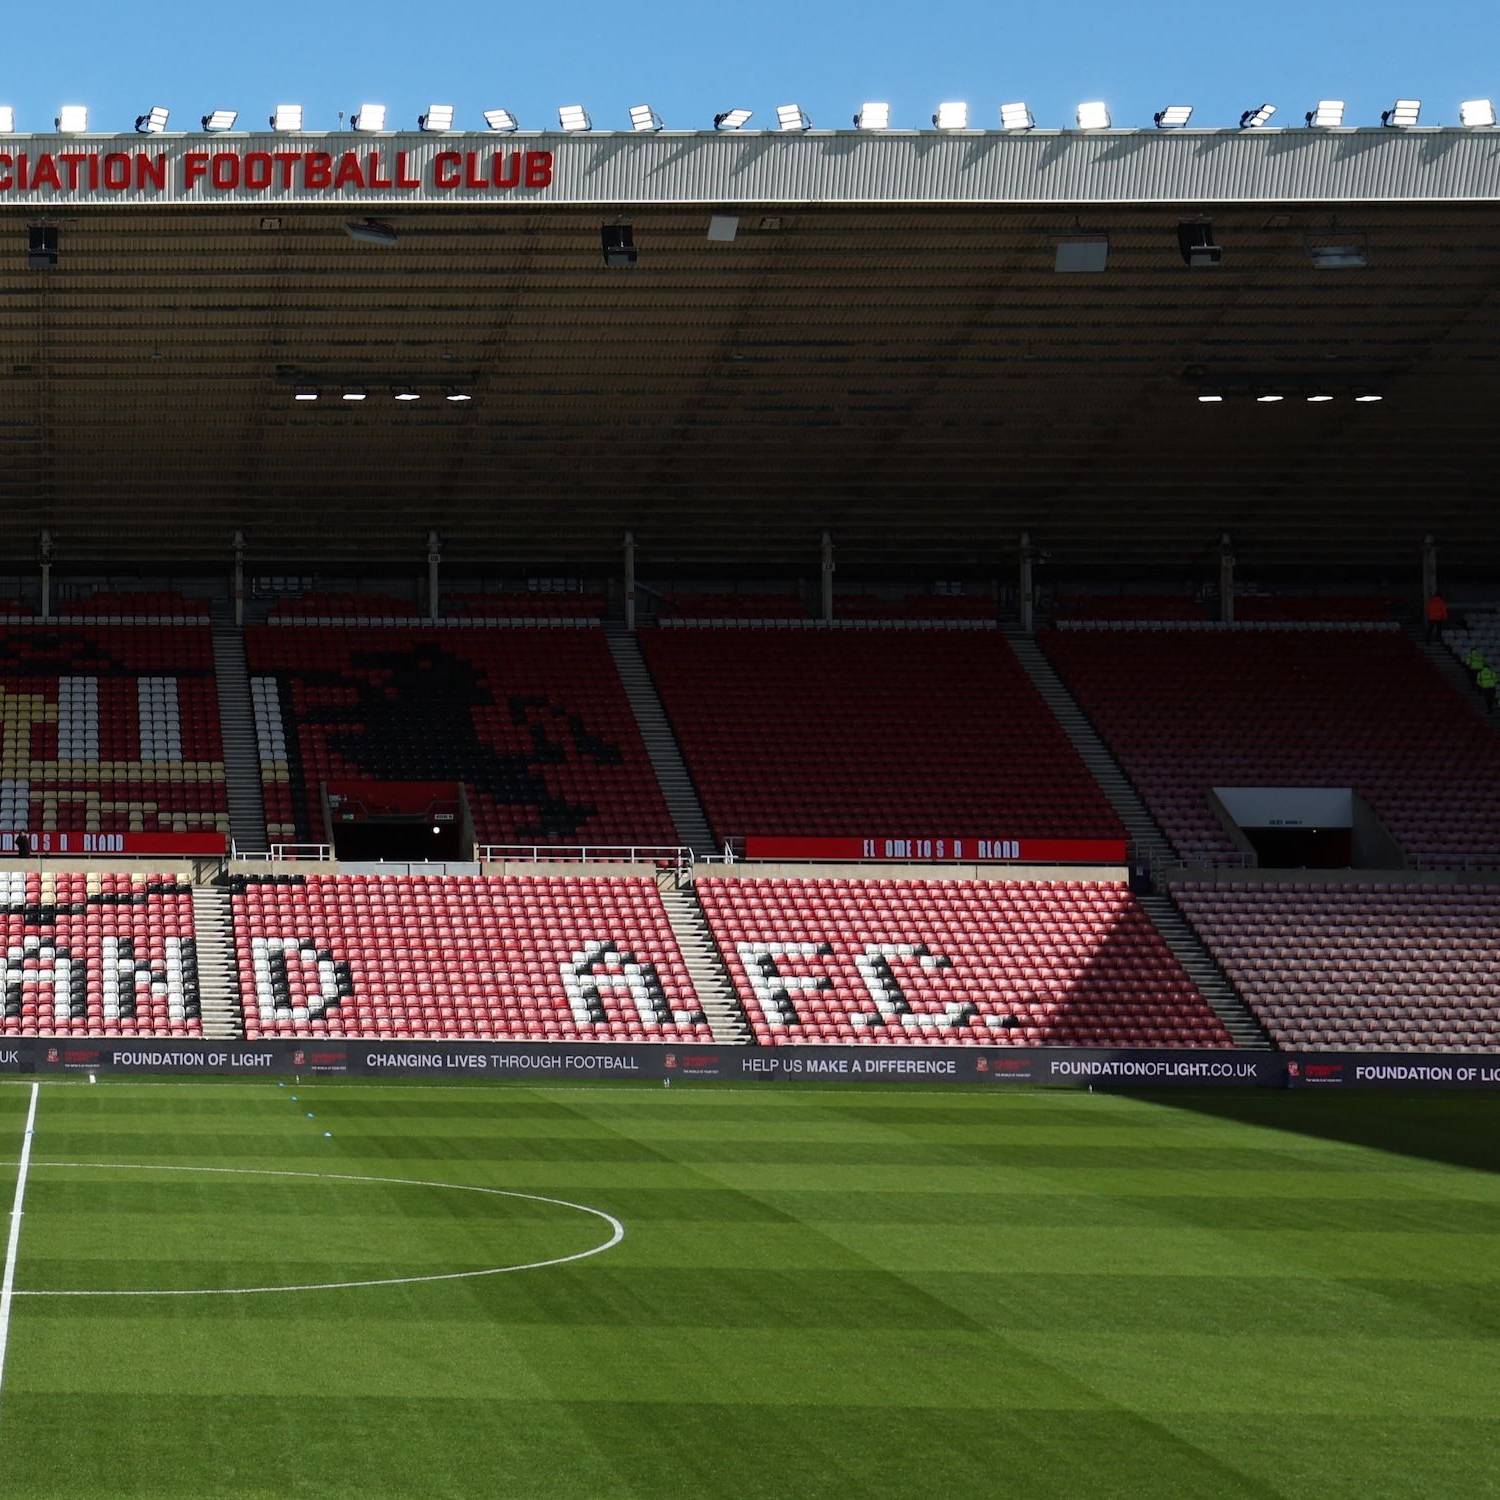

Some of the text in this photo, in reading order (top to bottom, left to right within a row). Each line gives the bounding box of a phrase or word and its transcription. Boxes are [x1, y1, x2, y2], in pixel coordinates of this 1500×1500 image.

[184, 151, 421, 190] FOOTBALL
[434, 150, 554, 188] CLUB
[113, 1052, 204, 1066] FOUNDATION
[207, 1052, 228, 1066] OF
[231, 1053, 273, 1067] LIGHT
[366, 1053, 639, 1070] CHANGING LIVES THROUGH FOOTBALL
[742, 1058, 957, 1074] HELP US MAKE A DIFFERENCE
[1050, 1061, 1257, 1077] FOUNDATIONOFLIGHT.CO.UK
[1356, 1066, 1453, 1081] FOUNDATION
[1456, 1067, 1477, 1081] OF
